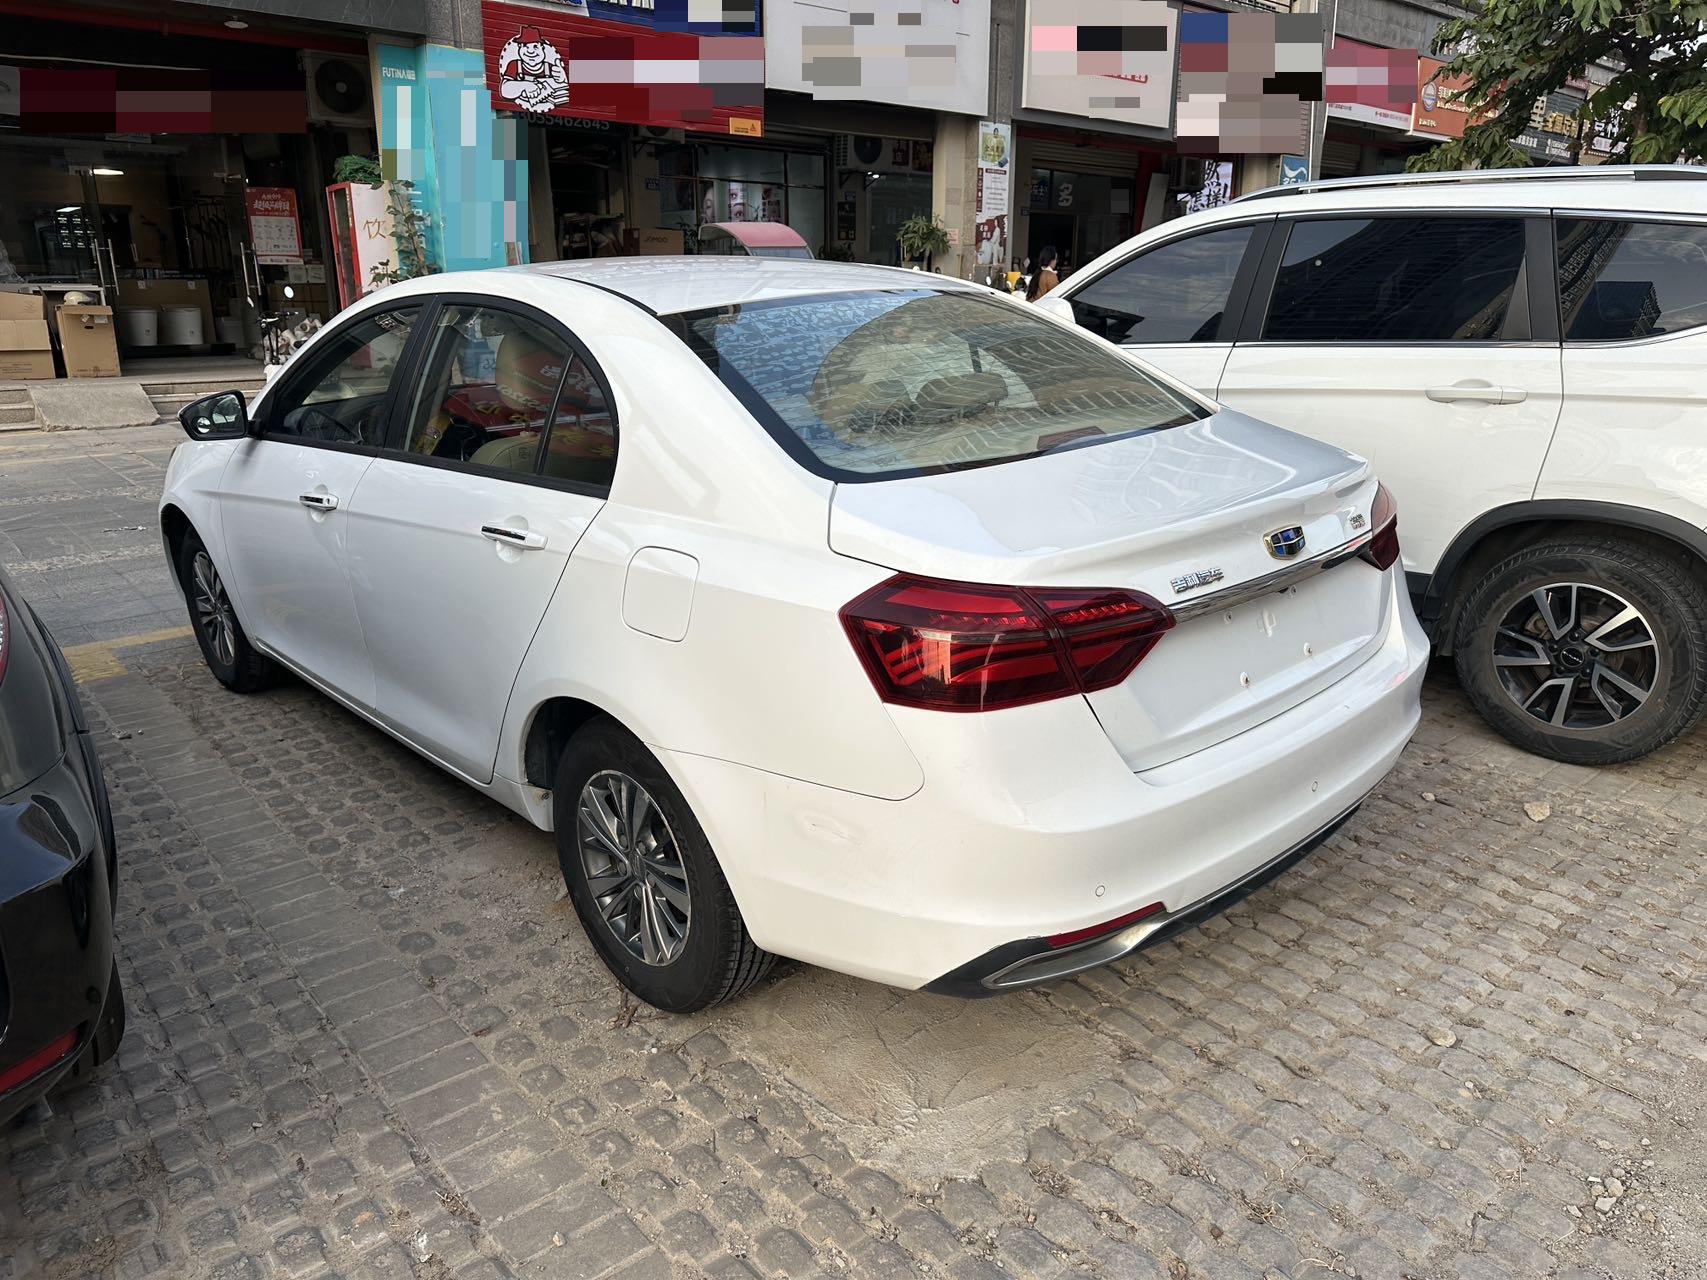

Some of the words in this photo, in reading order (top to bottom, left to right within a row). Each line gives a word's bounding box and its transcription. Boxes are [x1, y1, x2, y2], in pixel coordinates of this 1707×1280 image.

[363, 218, 387, 240] 饮
[644, 235, 668, 244] JOMOO
[1171, 567, 1224, 594] 吉利汽车
